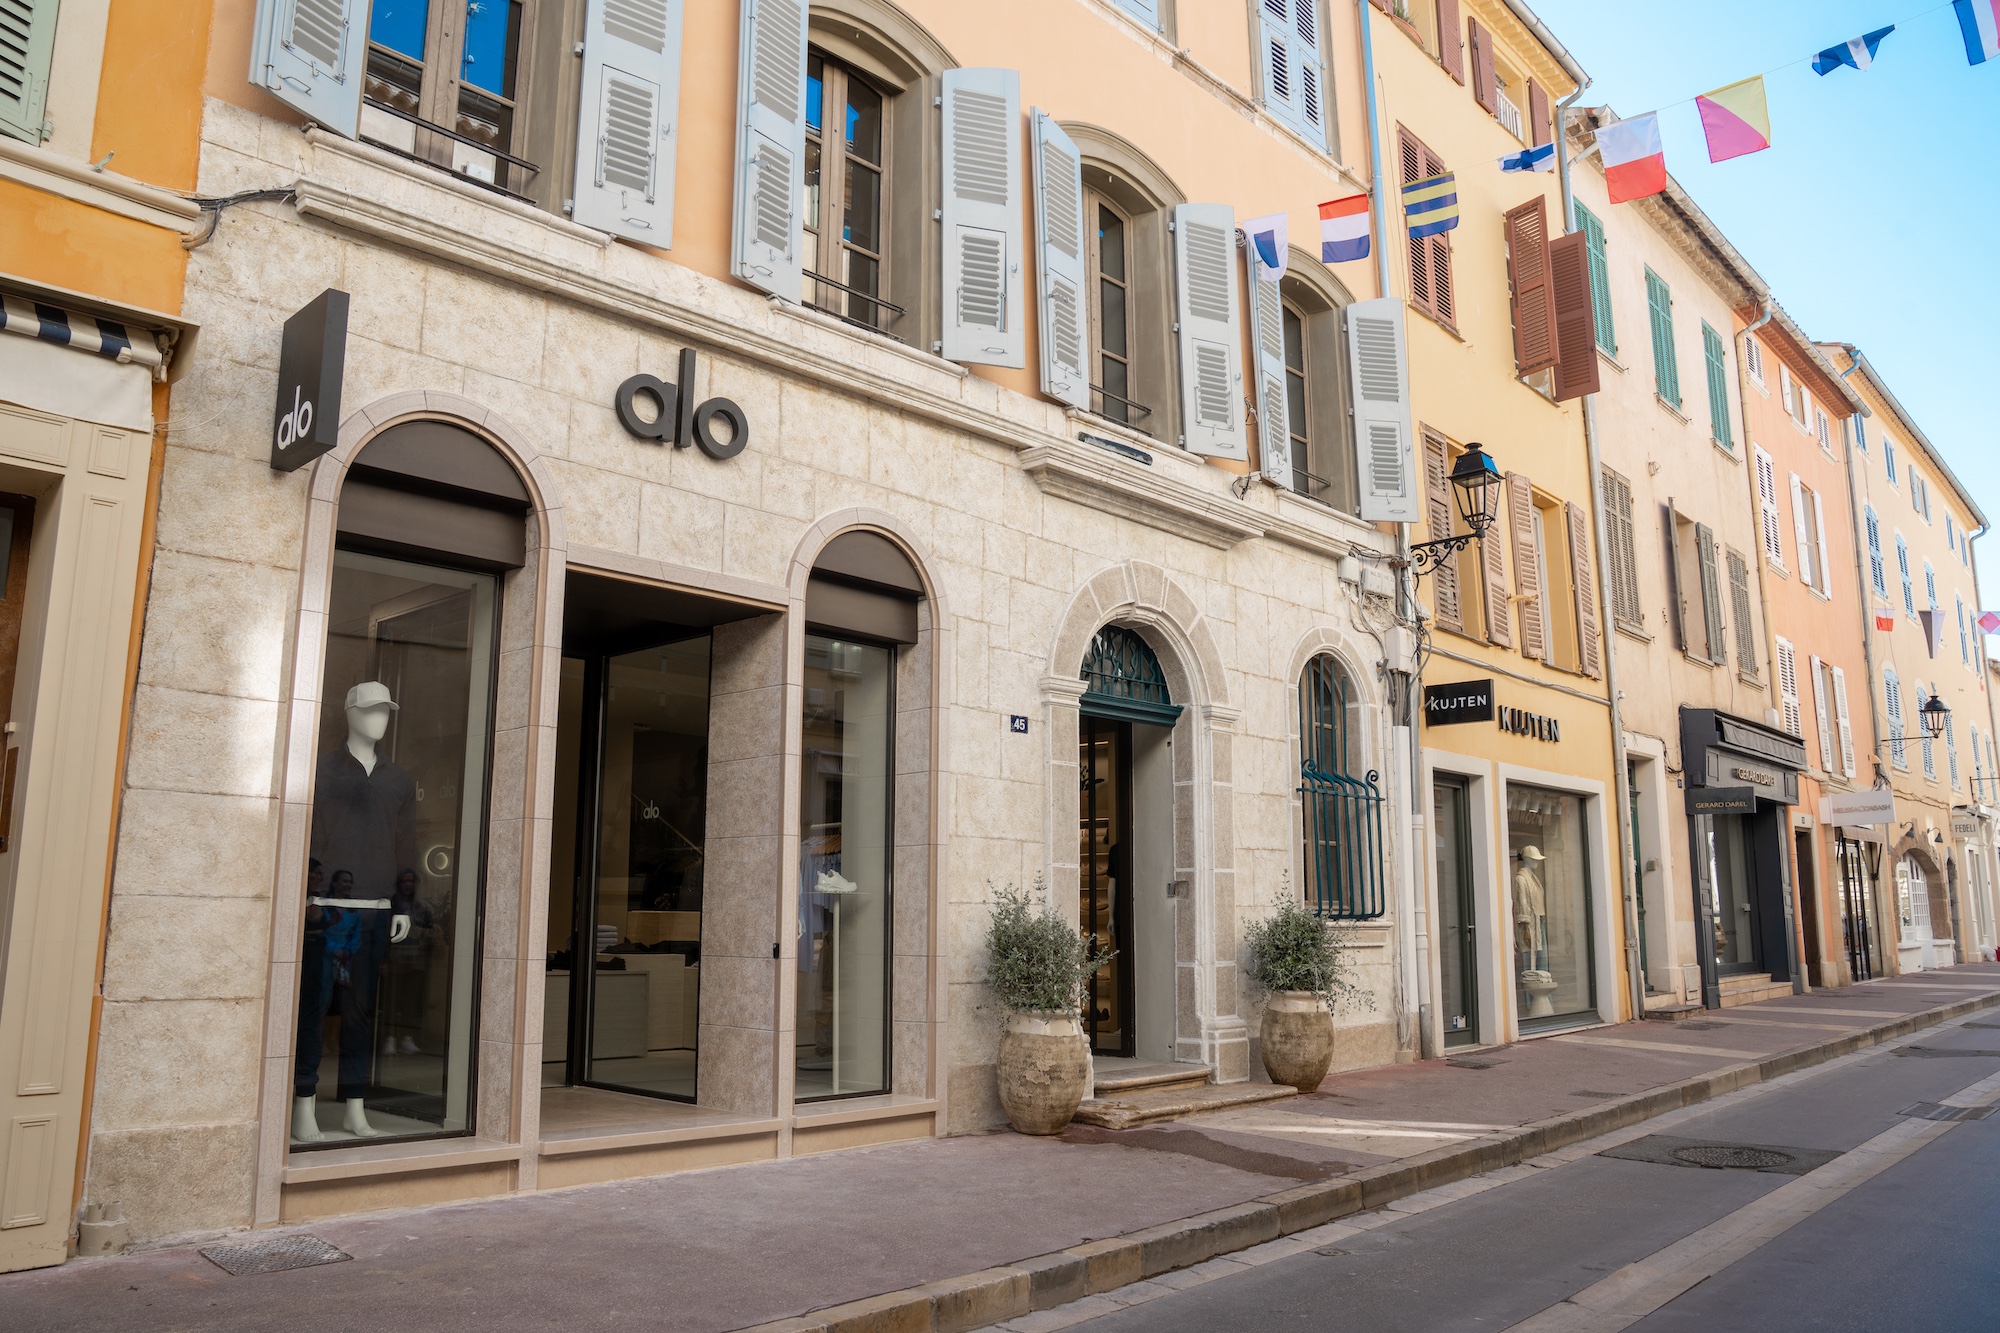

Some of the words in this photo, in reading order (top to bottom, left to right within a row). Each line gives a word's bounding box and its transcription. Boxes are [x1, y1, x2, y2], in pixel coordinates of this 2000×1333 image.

[615, 347, 749, 460] alo
[277, 384, 313, 451] alo
[1430, 694, 1487, 711] KUJTEN
[1014, 718, 1026, 731] 45
[1498, 705, 1560, 742] KUJTEN
[643, 799, 660, 820] alo
[1695, 801, 1725, 809] GERARD
[1955, 823, 1976, 833] FEDELI
